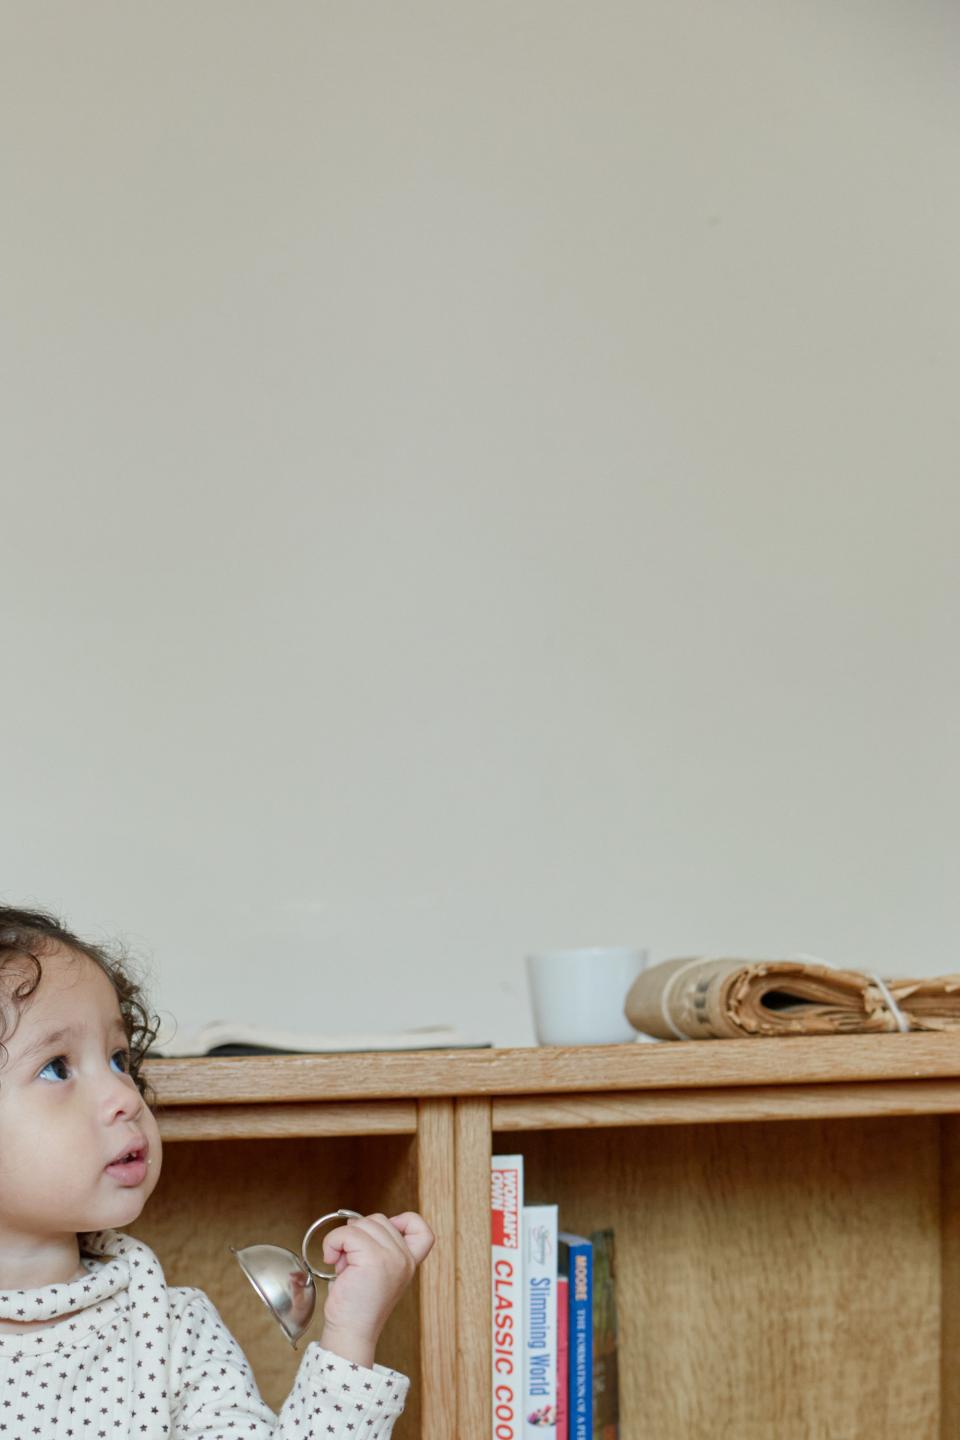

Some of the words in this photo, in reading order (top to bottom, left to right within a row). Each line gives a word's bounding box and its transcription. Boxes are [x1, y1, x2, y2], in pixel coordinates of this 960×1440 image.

[491, 1171, 503, 1211] OWN
[503, 1170, 517, 1248] WOMAN'S
[575, 1255, 587, 1301] MOORE
[494, 1259, 514, 1376] CLASSIC
[528, 1277, 551, 1349] Slimming
[576, 1309, 586, 1330] THE
[529, 1353, 550, 1396] World
[576, 1332, 586, 1398] FORMATION
[576, 1399, 586, 1413] OF
